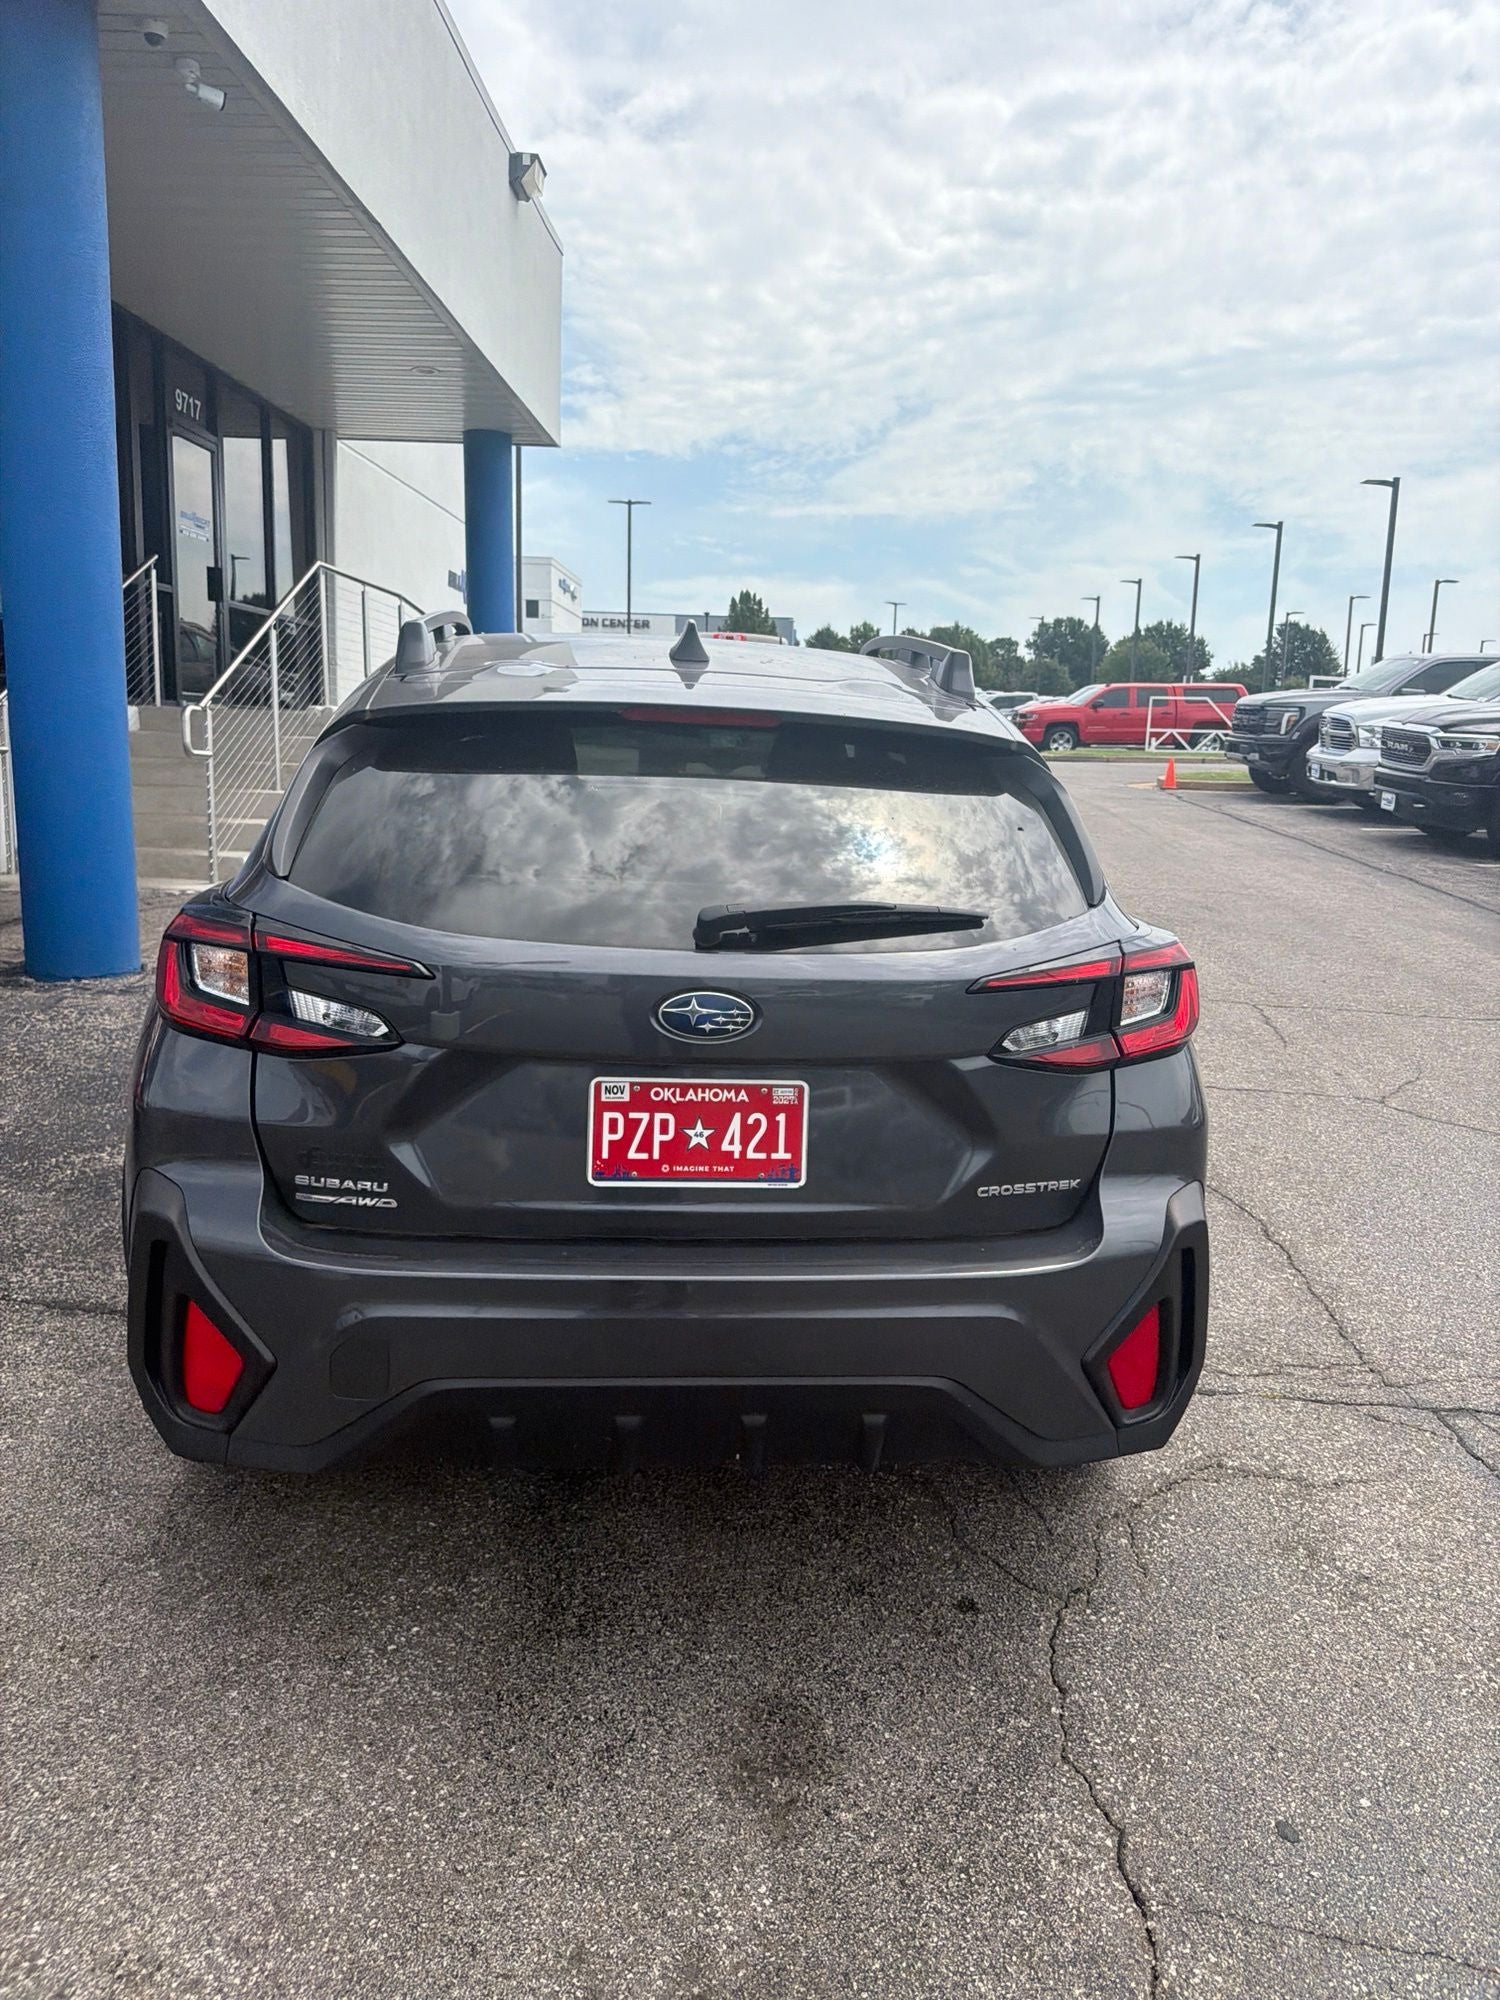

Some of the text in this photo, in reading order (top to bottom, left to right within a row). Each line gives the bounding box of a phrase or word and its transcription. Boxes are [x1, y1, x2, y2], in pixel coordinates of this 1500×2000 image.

[175, 388, 201, 420] 9717
[604, 1084, 626, 1095] NOV
[650, 1087, 749, 1104] OKLAHOMA
[601, 1111, 792, 1160] PZP 421
[294, 1175, 389, 1192] SUBARU
[977, 1178, 1081, 1197] CROSSTREK
[332, 1196, 398, 1208] AWD
